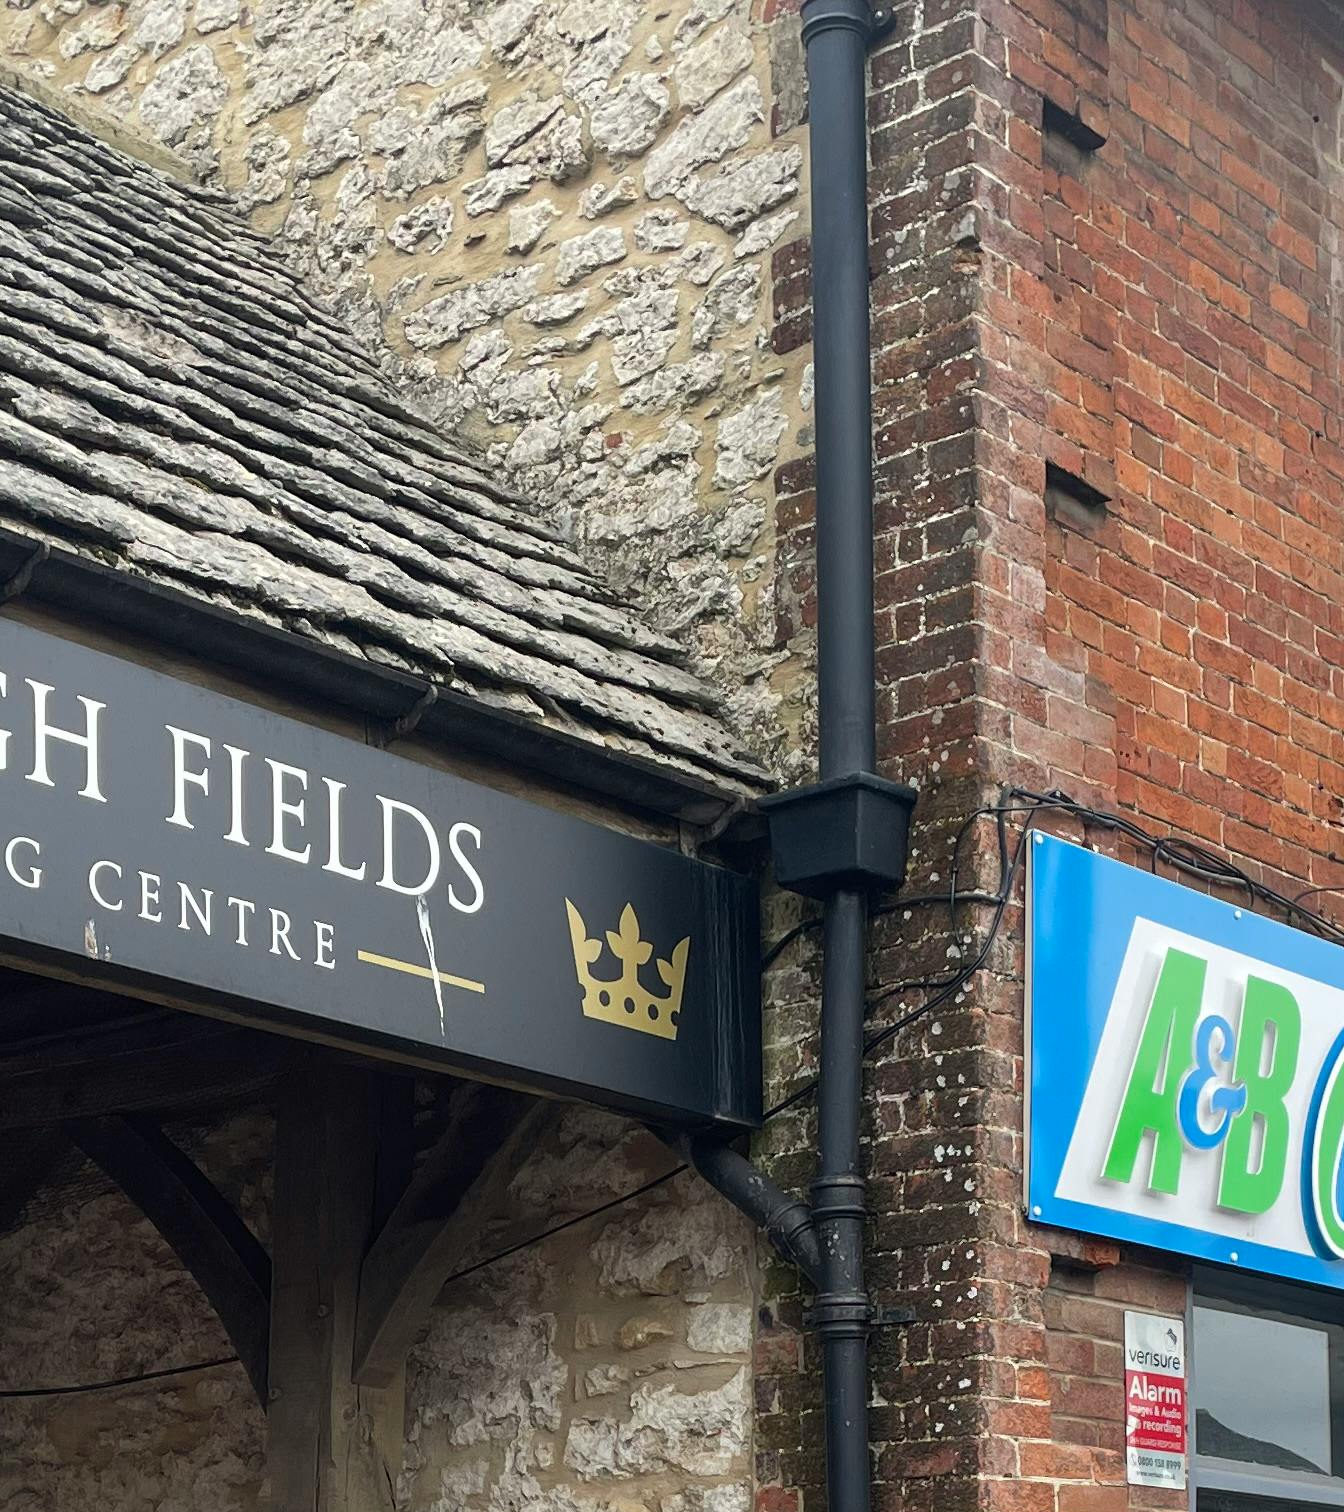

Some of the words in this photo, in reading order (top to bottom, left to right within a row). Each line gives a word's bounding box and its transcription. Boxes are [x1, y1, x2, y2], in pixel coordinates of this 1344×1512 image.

[165, 725, 486, 915] FIELDS
[88, 860, 337, 971] CENTRE
[1099, 946, 1303, 1215] A&B
[1129, 1349, 1181, 1371] verisure
[1129, 1376, 1182, 1405] Alarm
[1142, 1420, 1182, 1438] recording
